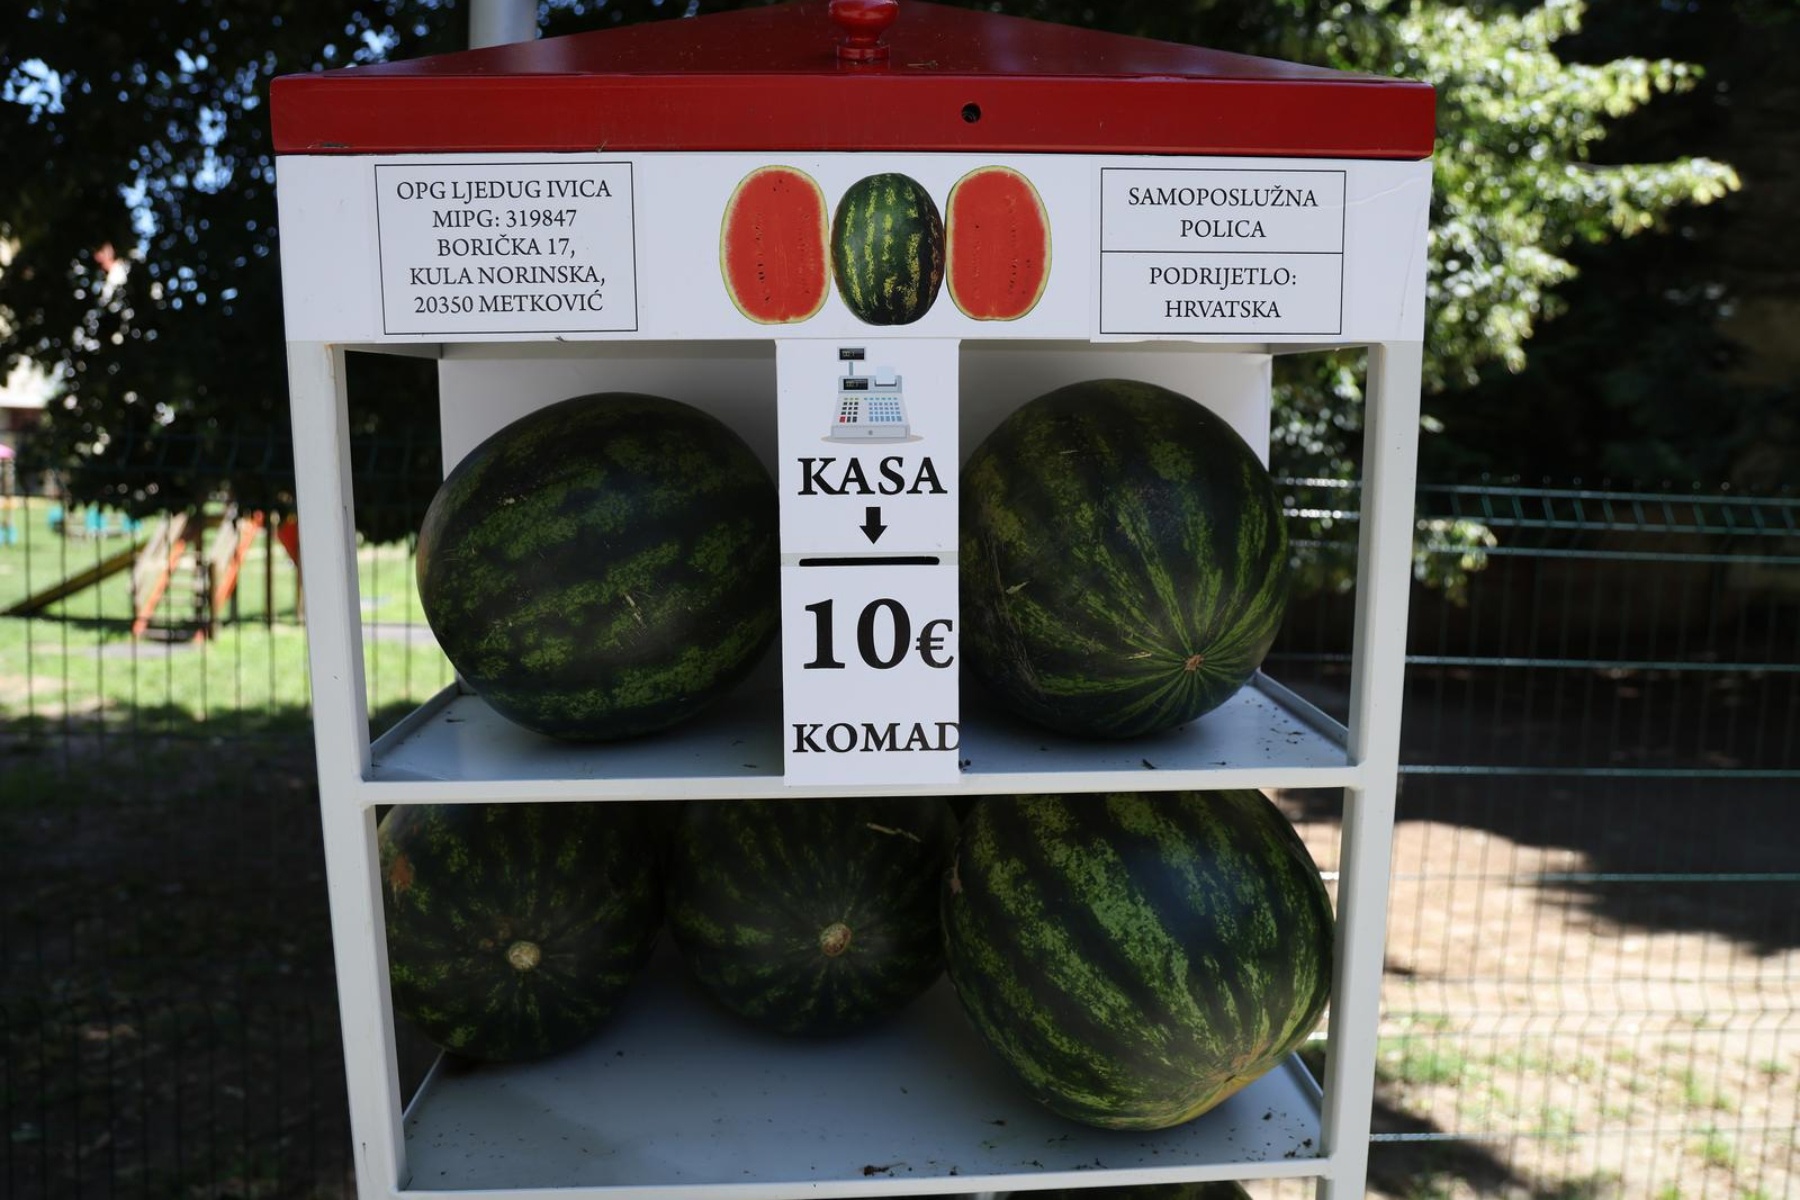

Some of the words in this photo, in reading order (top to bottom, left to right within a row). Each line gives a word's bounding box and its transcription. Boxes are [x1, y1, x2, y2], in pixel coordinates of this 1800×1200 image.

[396, 180, 446, 200] OPG
[450, 180, 541, 204] LJEDUG
[546, 178, 613, 198] IVICA
[1128, 184, 1320, 208] SAMOPOSLUŽNA
[432, 208, 500, 228] MIPG:
[506, 208, 578, 228] 319847
[1180, 219, 1268, 238] POLICA
[437, 234, 542, 257] BORIČKA
[548, 236, 575, 259] 17,
[410, 266, 474, 285] KULA
[478, 265, 606, 287] NORINSKA,
[1150, 266, 1297, 291] PODRIJETLO:
[414, 296, 474, 314] 20350
[478, 289, 604, 314] METKOVIĆ
[1164, 300, 1283, 318] HRVATSKA
[796, 456, 949, 496] KASA
[802, 597, 955, 670] 10€
[792, 722, 959, 754] KOMAD
